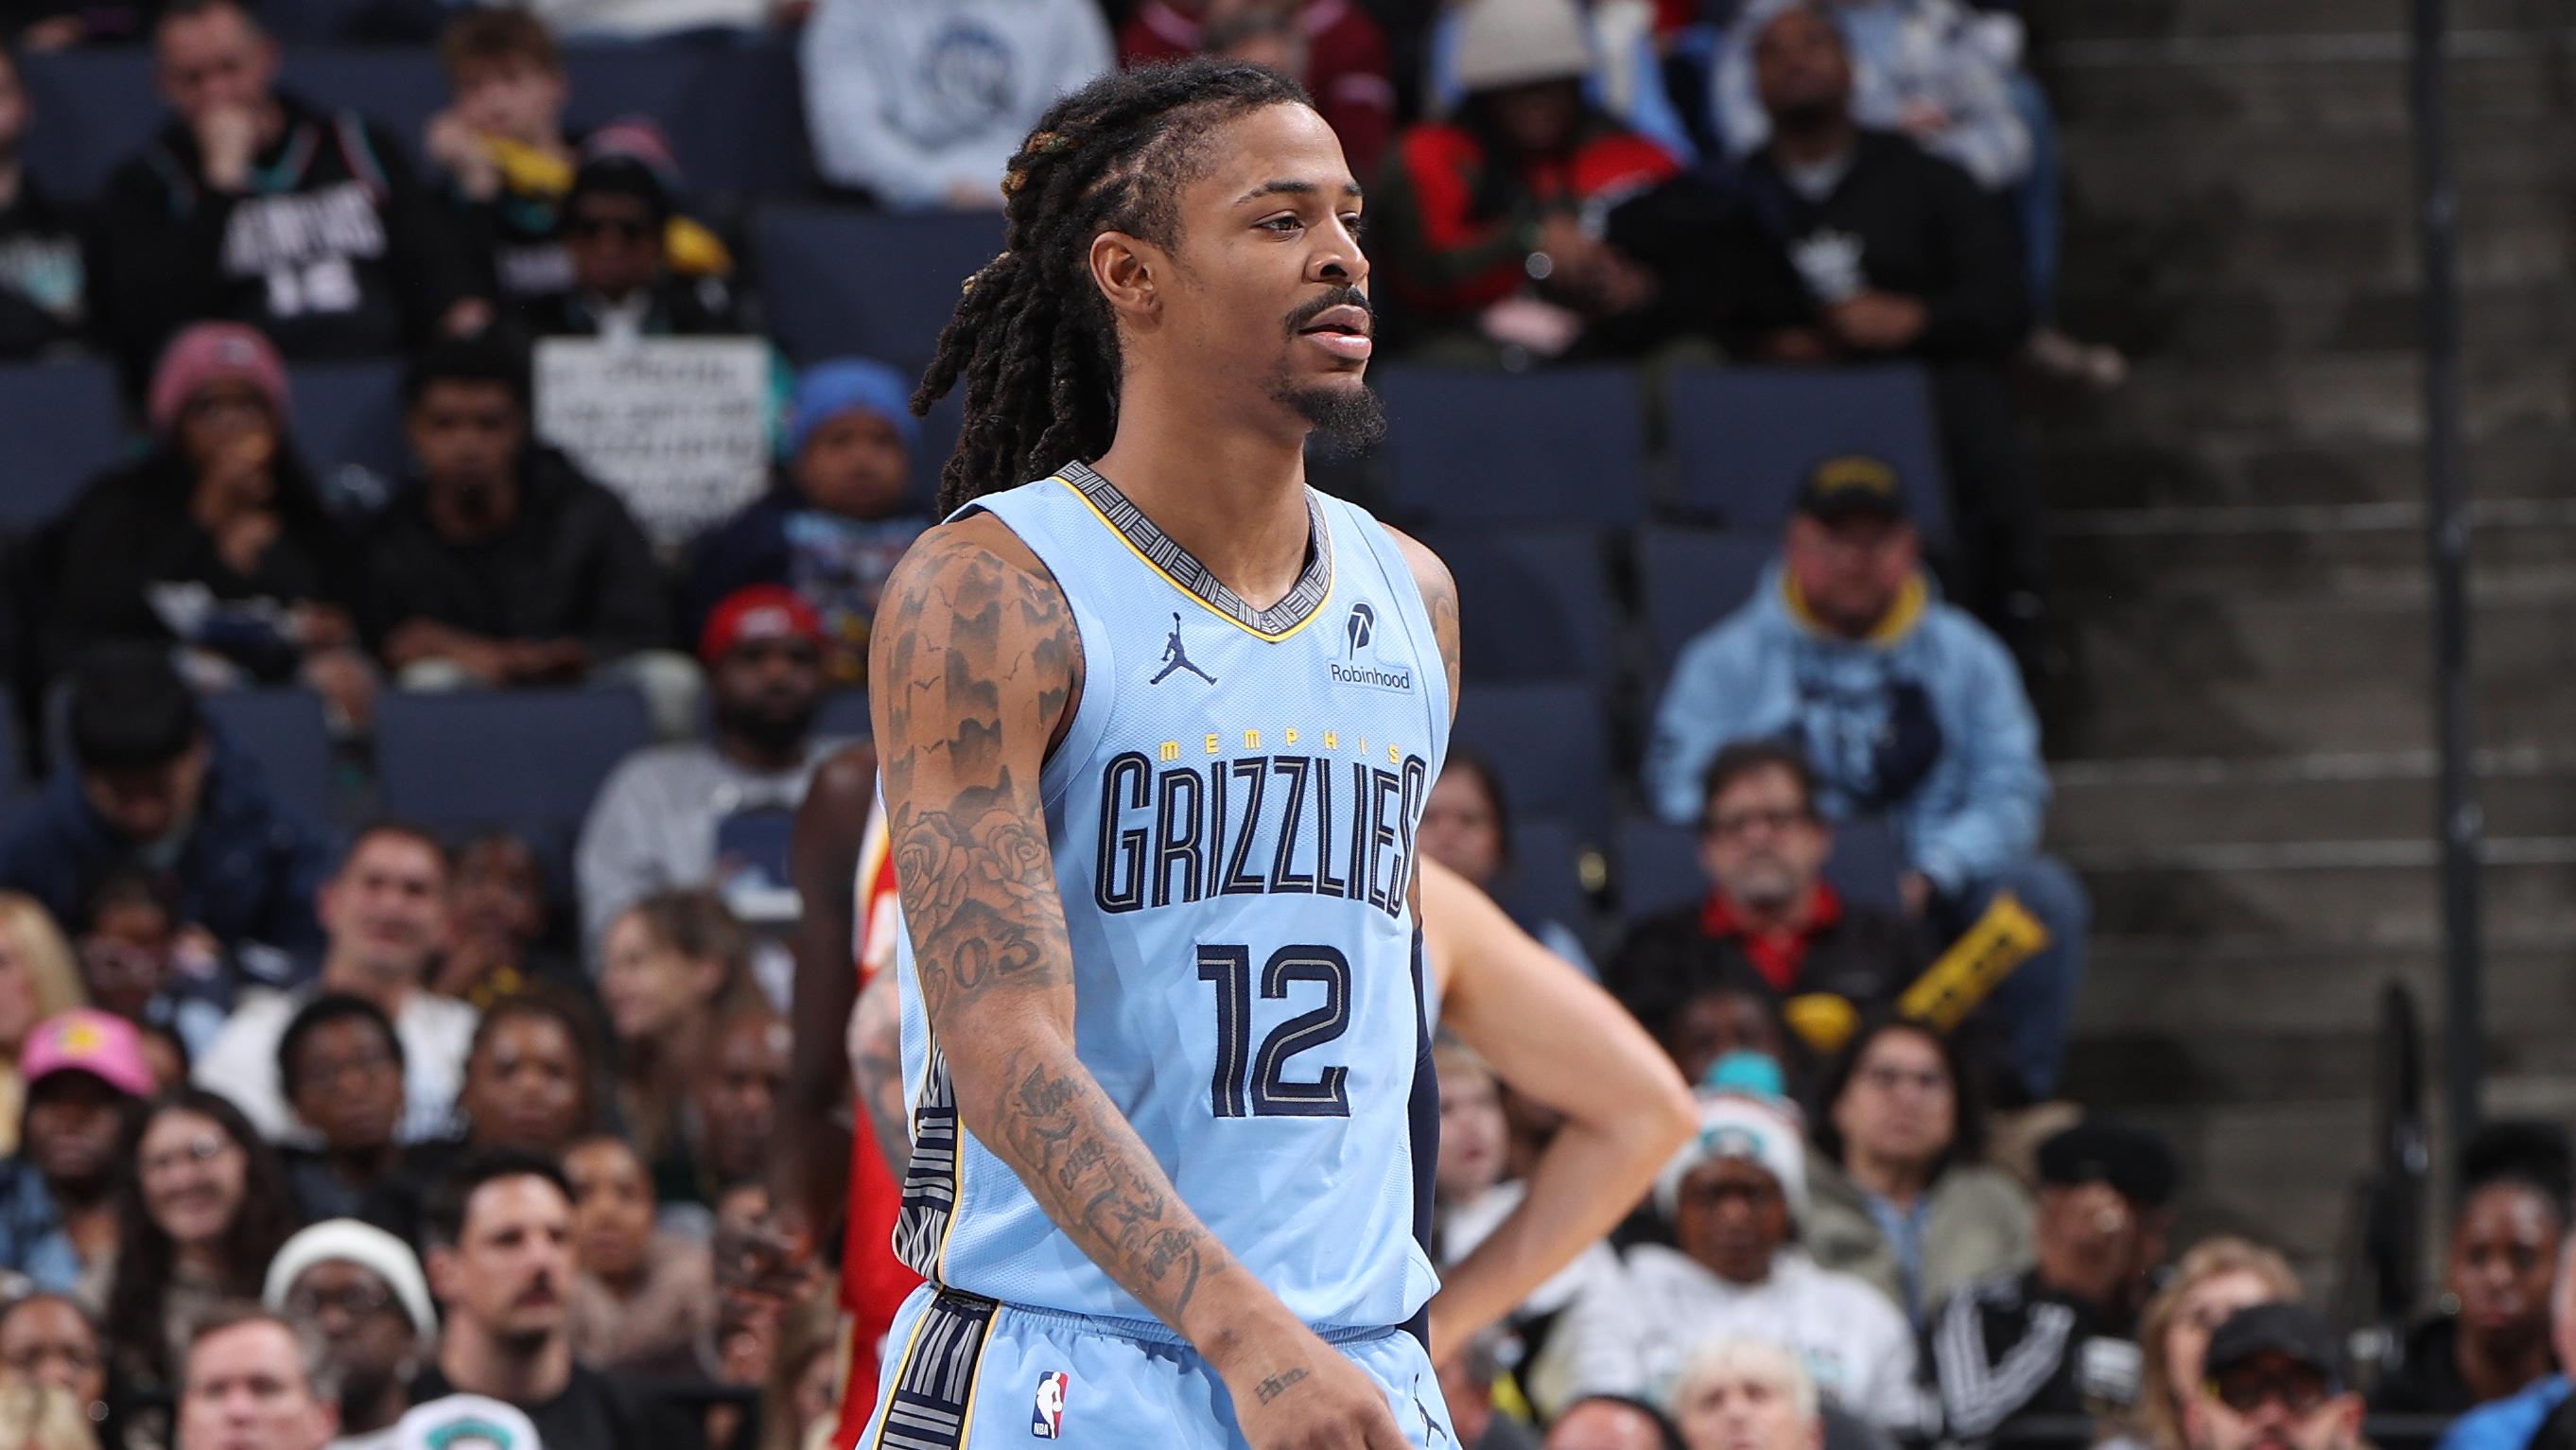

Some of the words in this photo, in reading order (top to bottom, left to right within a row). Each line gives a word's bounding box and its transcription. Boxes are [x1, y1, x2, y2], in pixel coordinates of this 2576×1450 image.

[1331, 664, 1410, 690] Robinhood
[1159, 727, 1401, 764] MEMPHIS
[1094, 751, 1427, 919] GRIZZLIES
[1196, 944, 1351, 1117] 12
[1034, 1422, 1049, 1436] NBA
